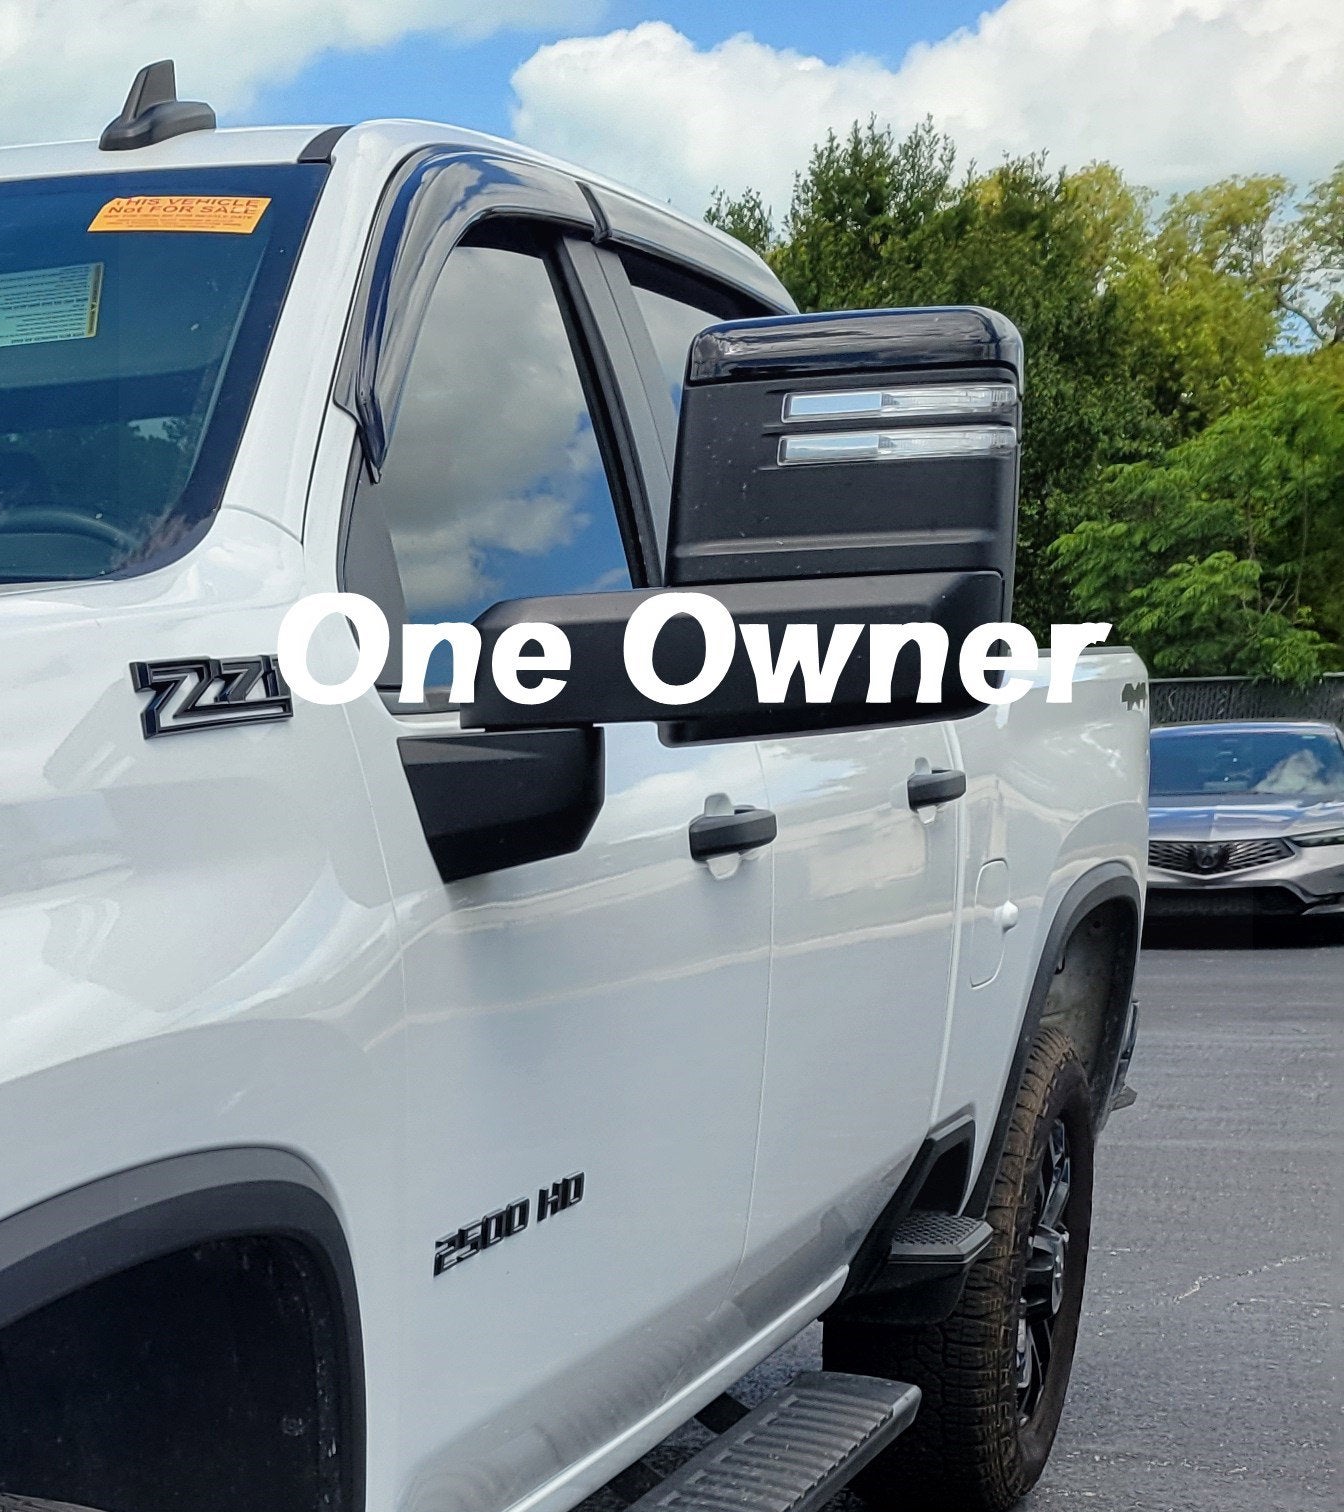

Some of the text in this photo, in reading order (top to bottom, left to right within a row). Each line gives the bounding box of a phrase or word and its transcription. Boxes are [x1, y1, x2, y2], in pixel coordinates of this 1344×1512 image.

[169, 199, 260, 207] VEHICLE
[149, 205, 193, 213] FOR
[200, 206, 257, 214] SALE
[432, 1171, 585, 1279] 2500 HD
